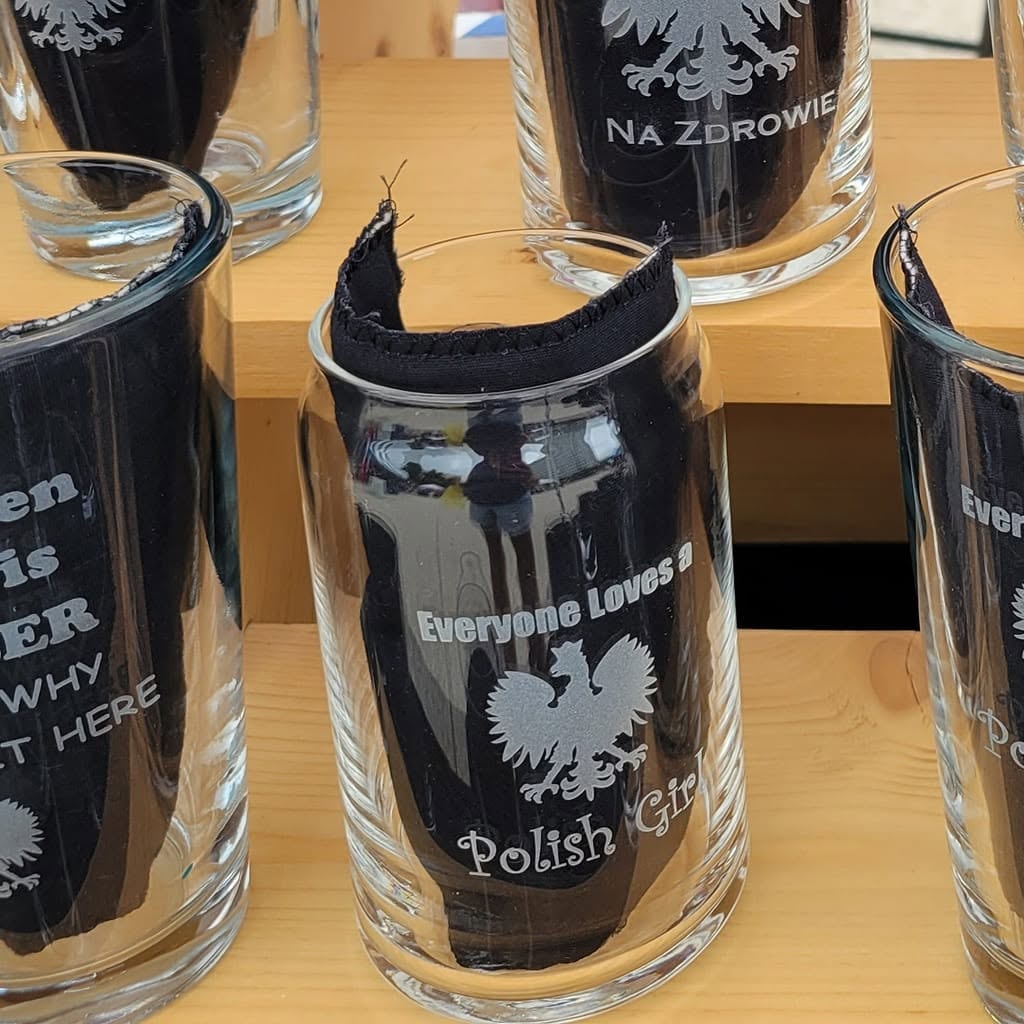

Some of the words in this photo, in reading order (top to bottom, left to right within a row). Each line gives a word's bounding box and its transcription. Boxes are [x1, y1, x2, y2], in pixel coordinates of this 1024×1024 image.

[606, 117, 664, 146] NA
[674, 89, 836, 146] ZDROWIE
[416, 599, 582, 643] Everyone
[587, 557, 675, 619] Loves
[678, 541, 693, 573] a
[0, 652, 103, 713] WHY
[53, 674, 161, 751] HERE
[457, 813, 617, 877] Polish
